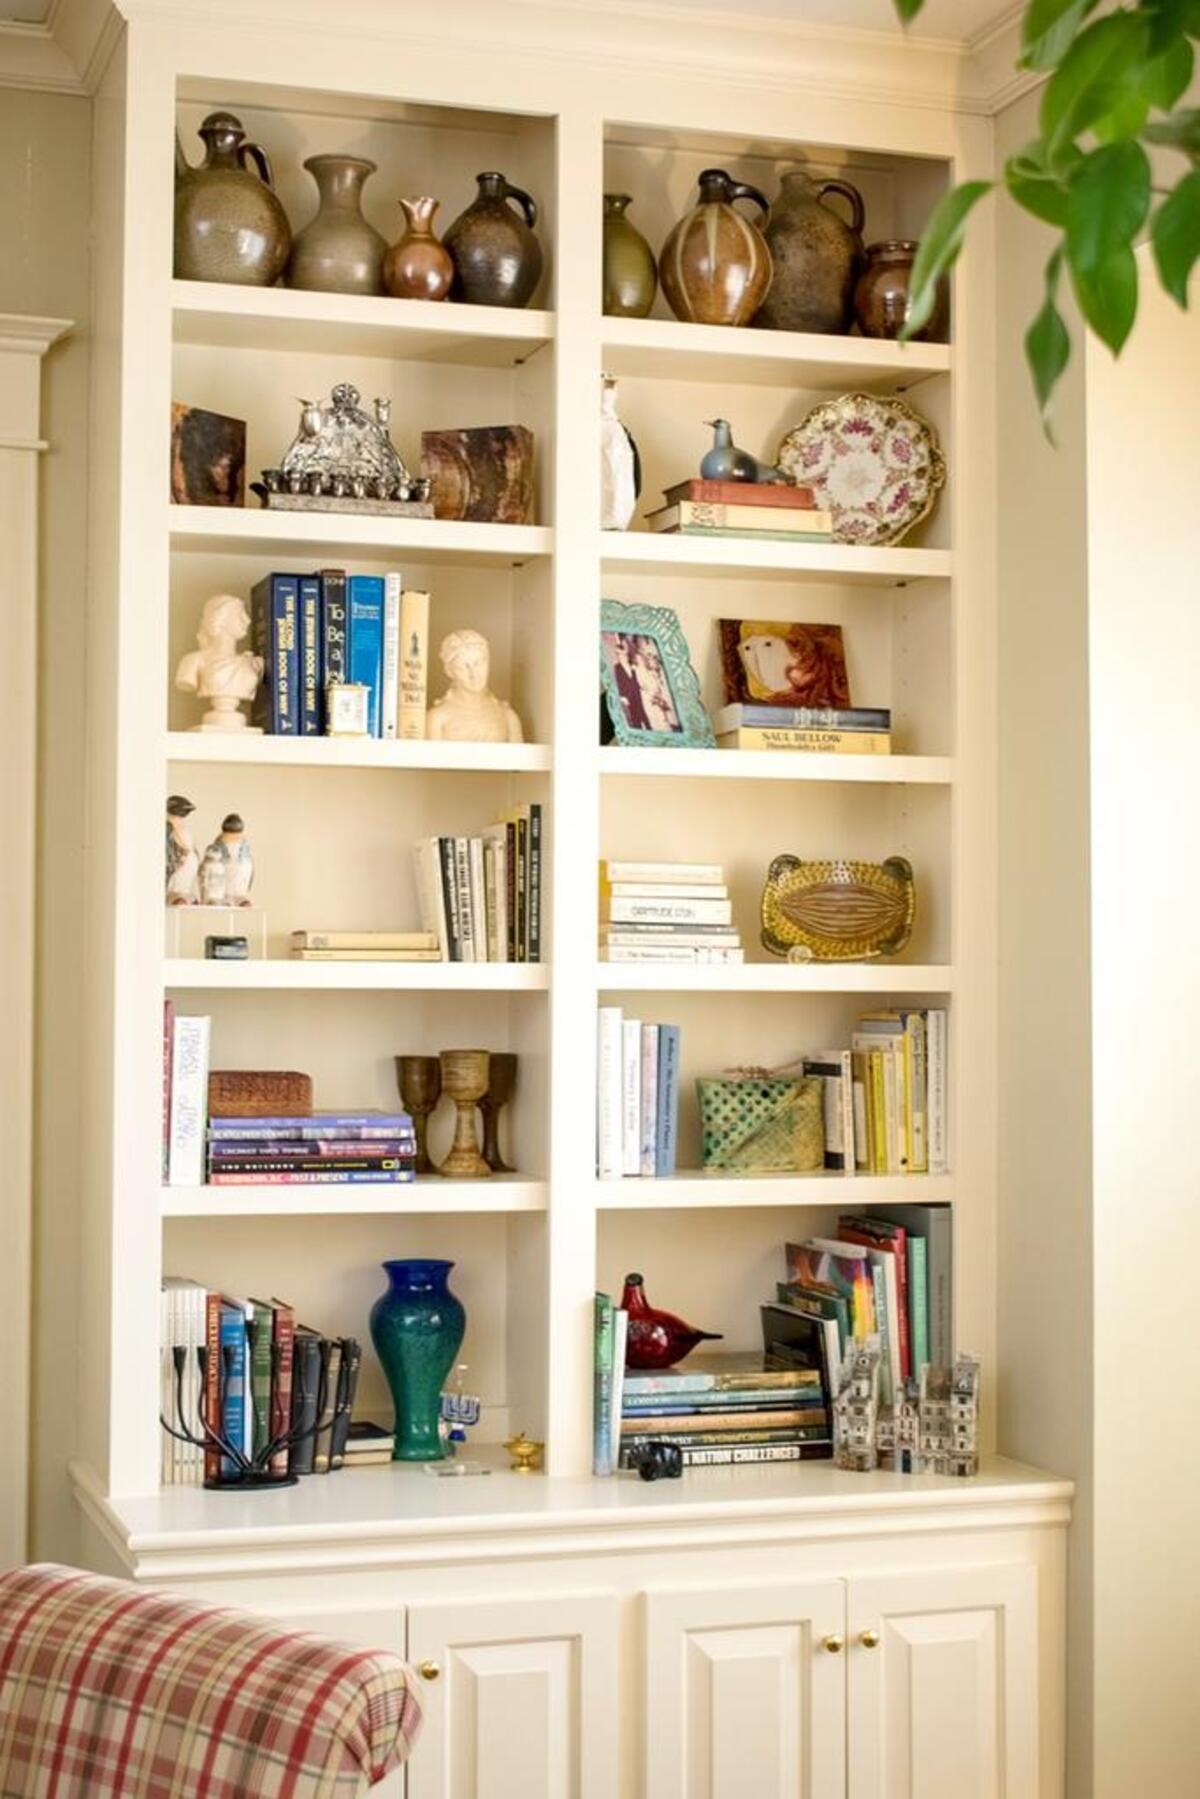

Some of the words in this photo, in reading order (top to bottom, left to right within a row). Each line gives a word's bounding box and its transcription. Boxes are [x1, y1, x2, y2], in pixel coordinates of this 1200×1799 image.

[285, 596, 295, 612] THE
[305, 599, 315, 615] THE
[328, 603, 345, 621] To
[327, 626, 345, 642] Be
[306, 649, 315, 676] BOOK
[331, 649, 341, 661] a
[278, 651, 288, 679] BOOK
[279, 680, 289, 692] OF
[306, 678, 315, 689] OF
[279, 693, 289, 715] WHY
[306, 690, 315, 712] WHY
[795, 733, 842, 743] BELLOW
[692, 1450, 731, 1464] NATION
[734, 1446, 801, 1462] CHALLENGED
